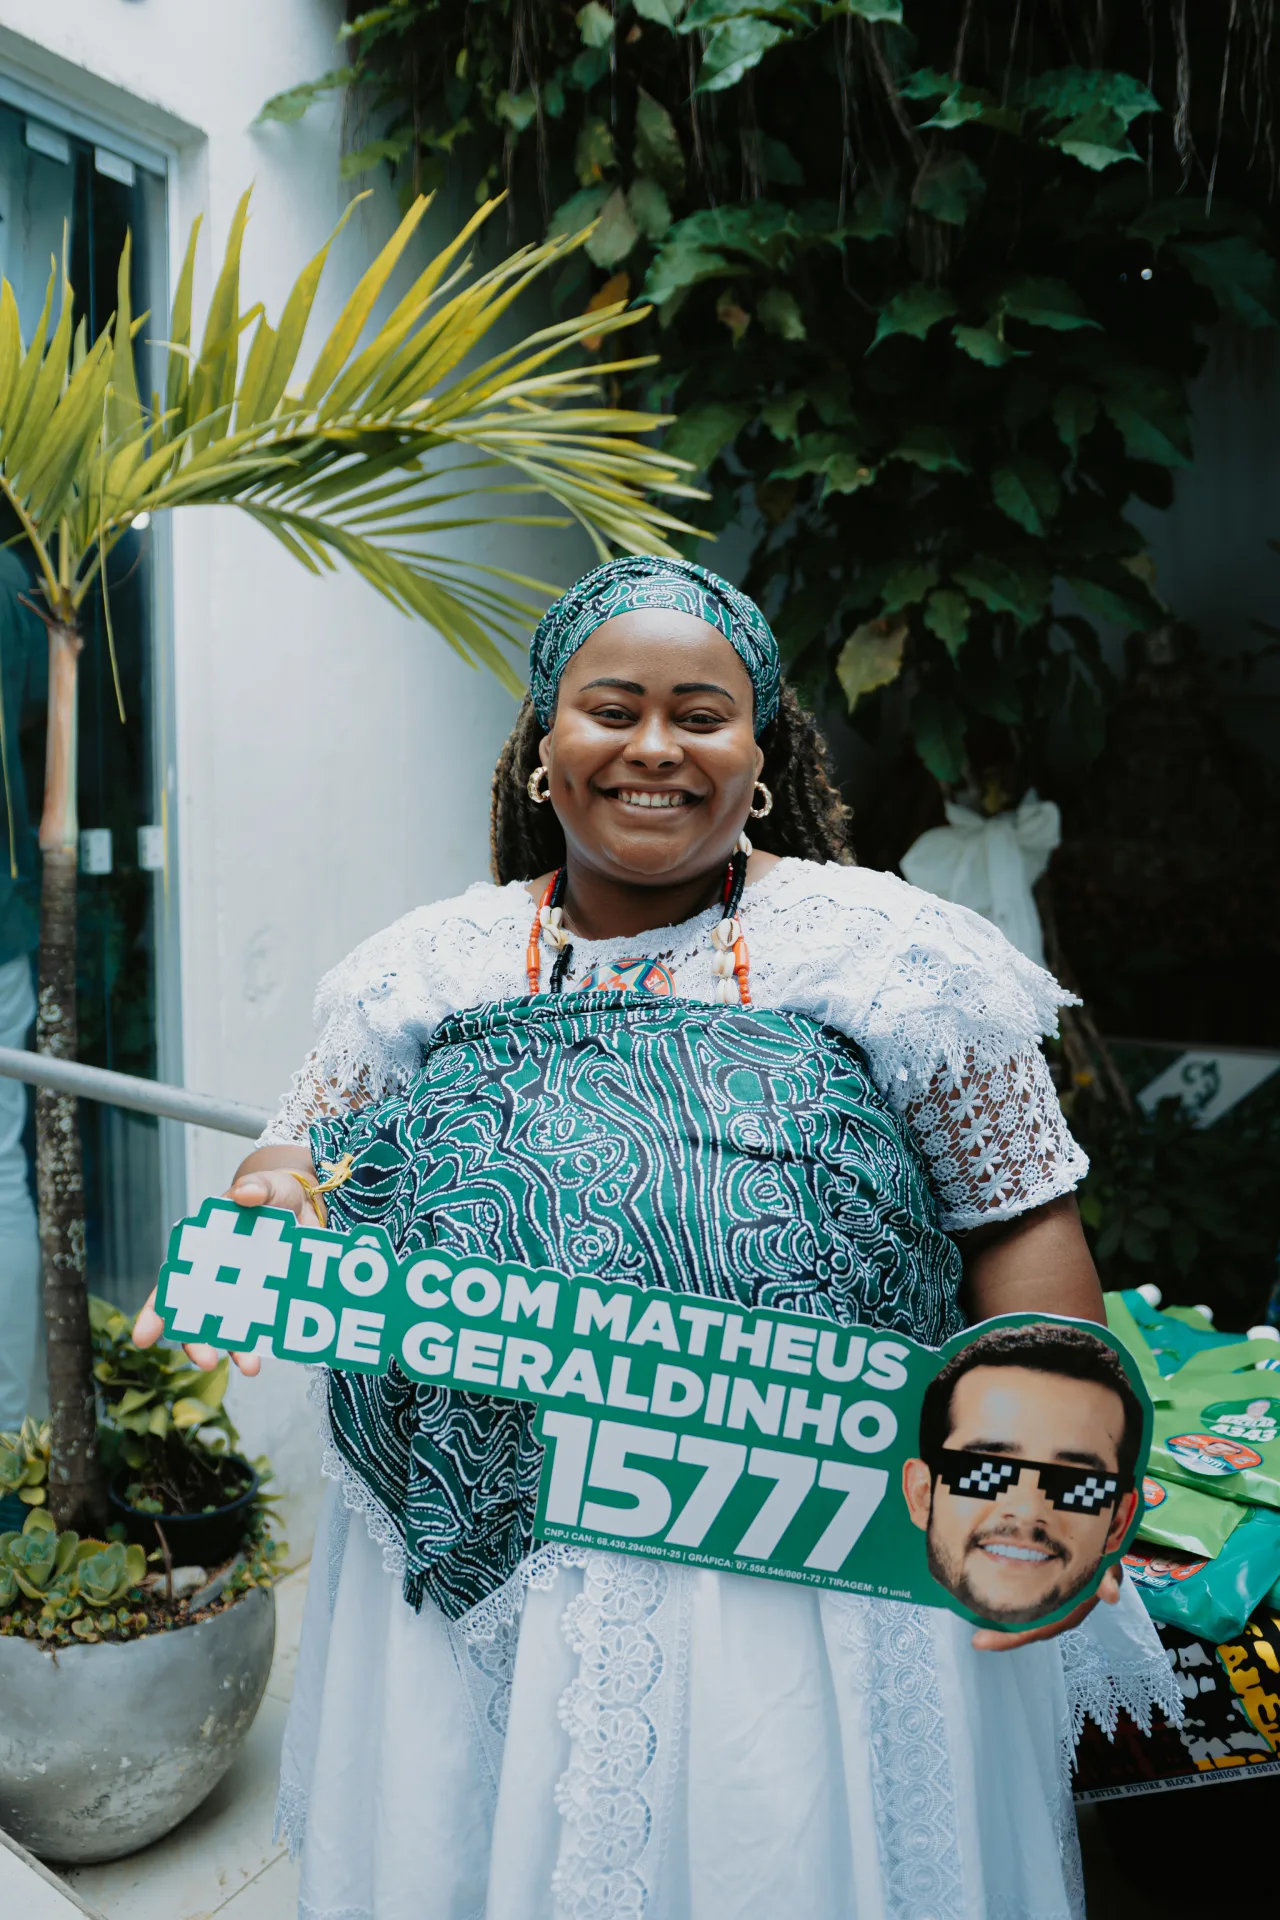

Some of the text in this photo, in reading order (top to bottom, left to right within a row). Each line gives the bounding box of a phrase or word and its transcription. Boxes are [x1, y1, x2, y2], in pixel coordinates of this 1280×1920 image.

[283, 1298, 898, 1454] DE GERALDINHO
[405, 1258, 560, 1330] COM
[573, 1286, 910, 1391] MATHEUS
[1209, 1423, 1277, 1442] 4343
[541, 1409, 890, 1573] 15777
[543, 1527, 570, 1540] CNPJ
[571, 1532, 595, 1544] CAN:
[688, 1552, 733, 1568] GRÁFICA:
[828, 1576, 874, 1593] TIRAGEM:
[877, 1586, 888, 1595] 10
[889, 1588, 912, 1600] unid.
[1089, 1787, 1122, 1799] BETTER
[1126, 1781, 1162, 1794] FUTURE
[1164, 1776, 1197, 1788] BLOCK
[1199, 1768, 1242, 1782] FASHION
